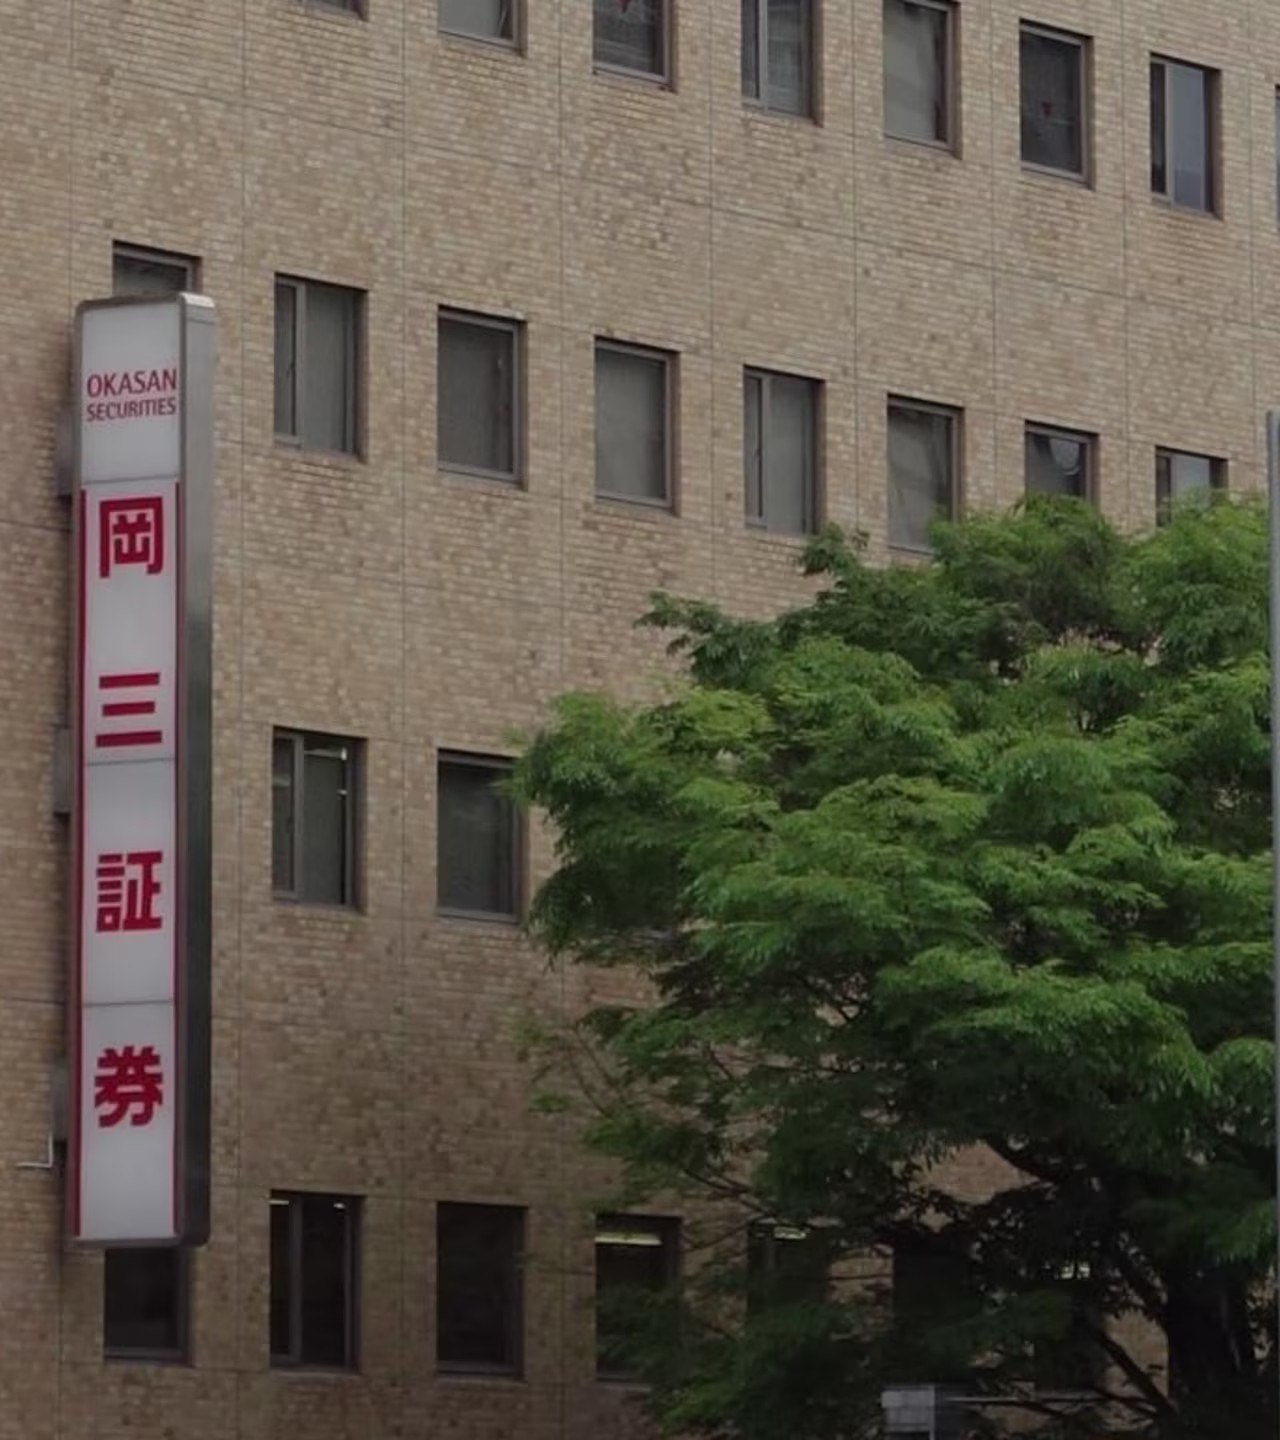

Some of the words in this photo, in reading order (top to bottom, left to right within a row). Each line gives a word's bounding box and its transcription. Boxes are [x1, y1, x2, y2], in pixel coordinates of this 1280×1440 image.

[86, 368, 178, 398] OKASAN
[85, 397, 177, 423] SECURITIES
[94, 496, 164, 1128] 岡三証券
